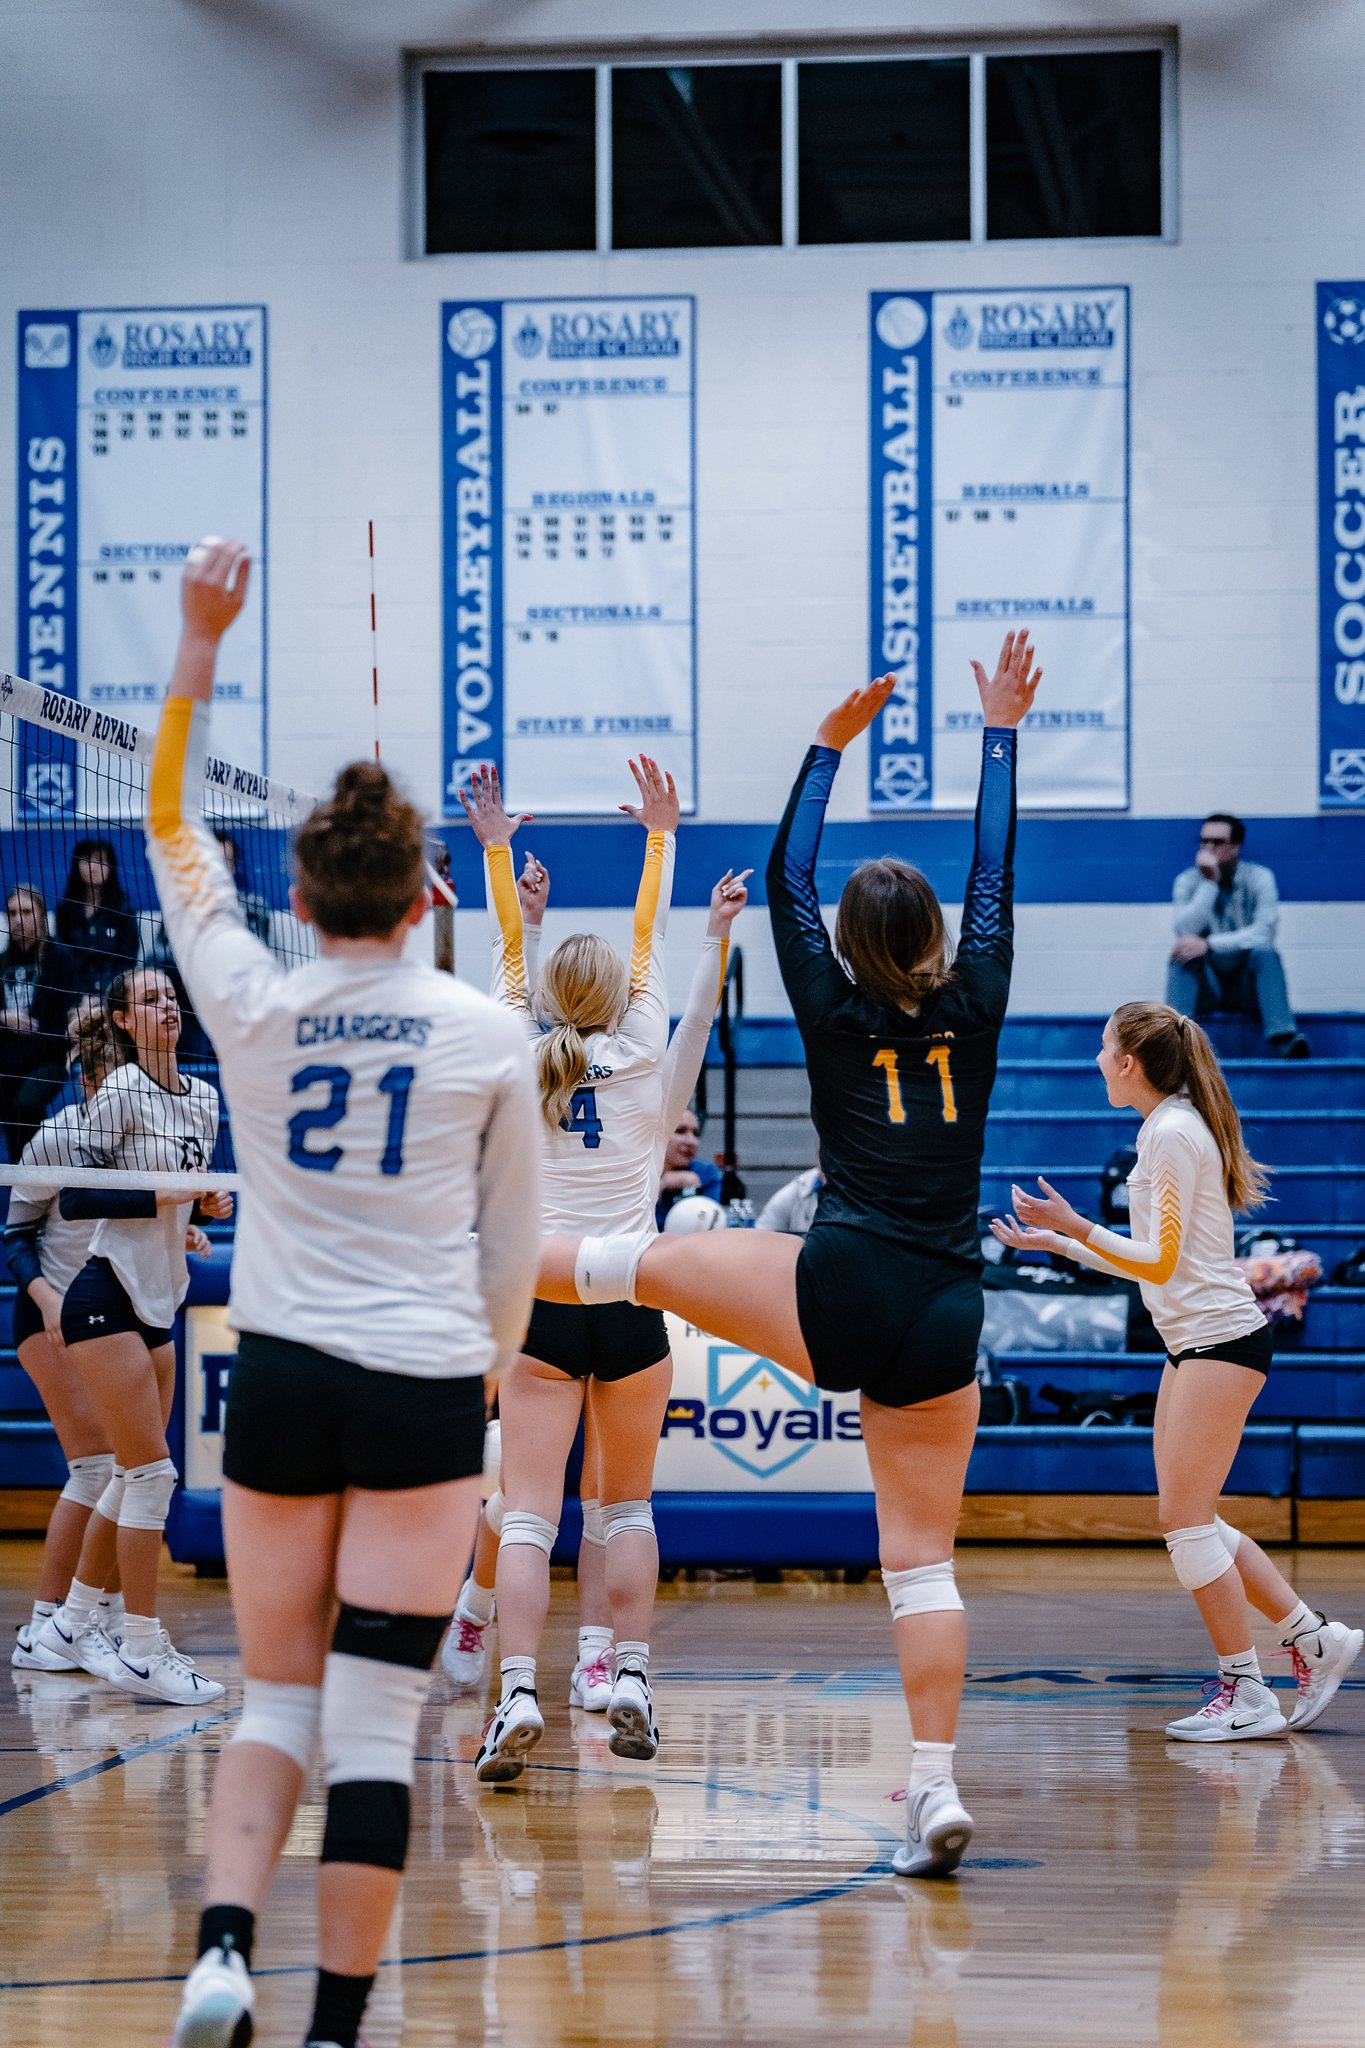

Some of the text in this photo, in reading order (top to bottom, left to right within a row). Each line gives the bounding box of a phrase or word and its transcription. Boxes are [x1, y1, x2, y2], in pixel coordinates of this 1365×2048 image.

[551, 310, 678, 343] ROSARY
[980, 302, 1114, 334] ROSARY
[124, 319, 253, 351] ROSARY
[519, 378, 667, 395] CONFERENCE
[950, 368, 1100, 385] CONFERENCE
[93, 386, 239, 403] CONFERENCE
[532, 491, 655, 507] REGIONALS
[962, 484, 1089, 499] REGIONALS
[28, 436, 66, 690] TENNIS
[101, 545, 192, 560] SECTION
[456, 358, 493, 754] VOLLEYBALL
[883, 355, 919, 745] BASKETBALL
[527, 605, 661, 621] SECTIONALS
[956, 598, 1095, 615] SECTIONALS
[91, 683, 155, 699] STATE
[40, 690, 138, 752] ROSARY ROYALS
[517, 716, 673, 734] STATE FINISH
[946, 712, 984, 728] STA
[205, 755, 231, 786] SARY
[233, 769, 268, 800] ROYALS
[296, 1014, 434, 1048] CHARGERS
[871, 1045, 959, 1123] 11
[288, 1065, 415, 1176] 21
[660, 1398, 865, 1451] Royals
